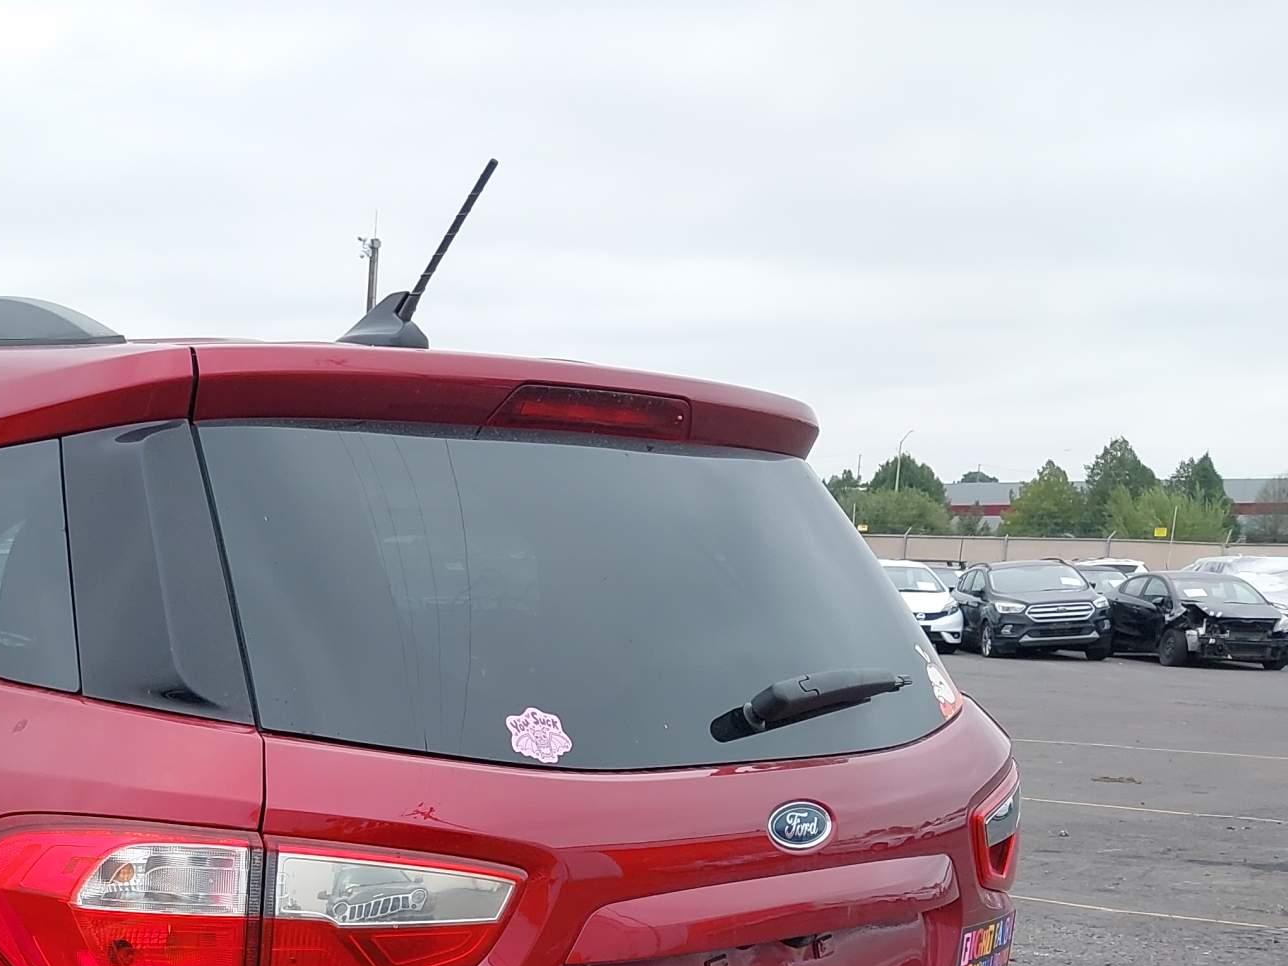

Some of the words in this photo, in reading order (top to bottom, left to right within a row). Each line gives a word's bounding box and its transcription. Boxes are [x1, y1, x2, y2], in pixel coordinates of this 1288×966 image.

[509, 719, 530, 734] You
[531, 711, 560, 730] Suck
[784, 811, 819, 839] Ford
